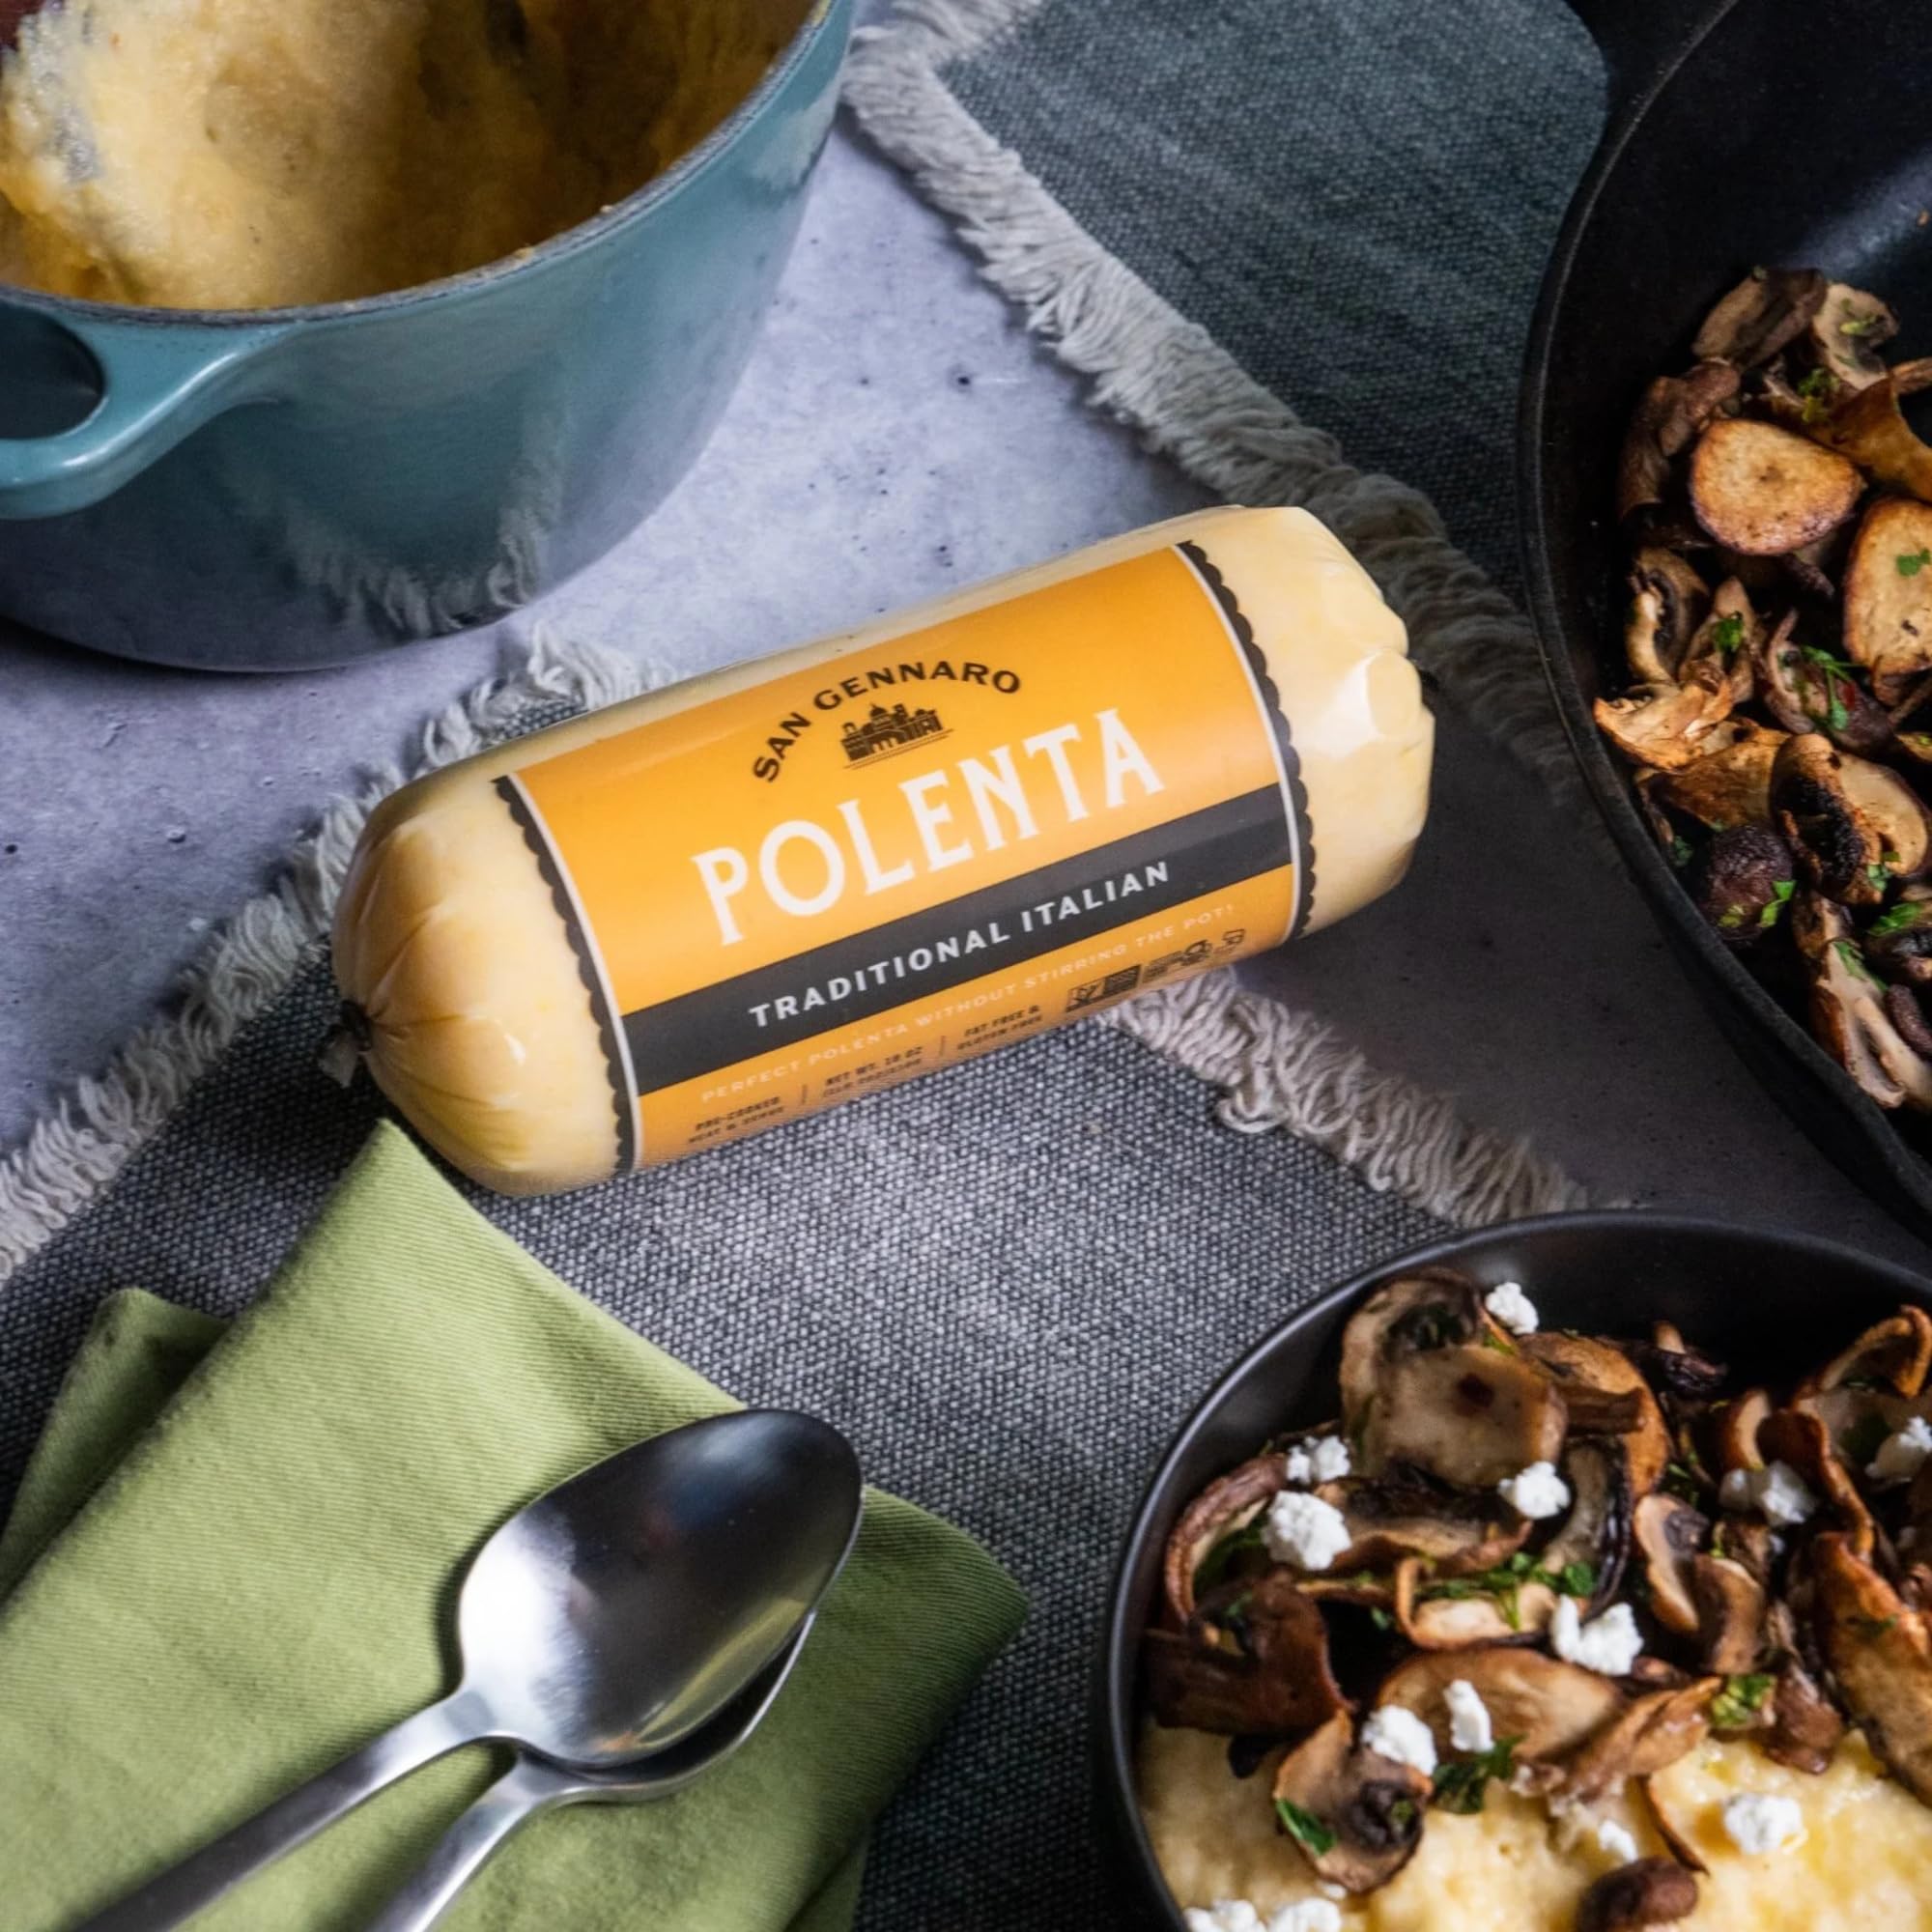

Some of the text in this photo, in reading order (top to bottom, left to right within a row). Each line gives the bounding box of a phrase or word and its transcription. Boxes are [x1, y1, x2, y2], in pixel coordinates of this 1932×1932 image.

[753, 661, 1021, 782] SAN GENNARO
[691, 708, 1166, 947] POLENTA
[701, 1060, 801, 1103] PERFECT
[808, 1023, 908, 1065] POLENTA
[914, 982, 1016, 1027] WITHOUT
[1024, 944, 1127, 989] STIRRING
[1136, 925, 1176, 948] THE
[749, 922, 1011, 1029] TRADITIONAL
[1020, 860, 1169, 932] ITALIAN
